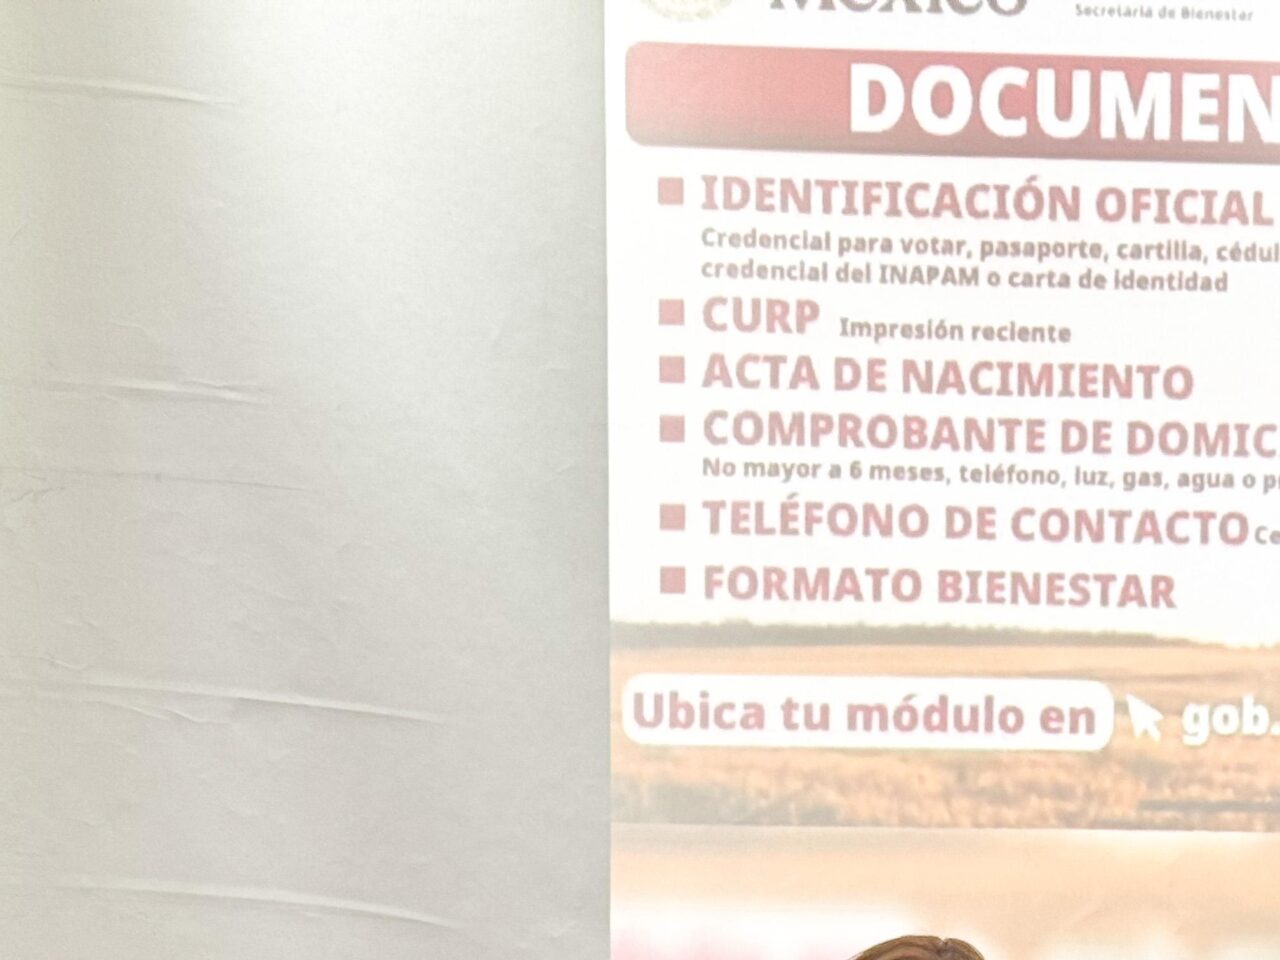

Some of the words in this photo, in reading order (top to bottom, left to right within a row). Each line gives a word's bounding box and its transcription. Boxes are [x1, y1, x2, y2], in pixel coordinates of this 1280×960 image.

[701, 175, 1080, 222] IDENTIFICACIÓN
[1095, 186, 1274, 226] OFICIAL
[701, 228, 831, 254] Credencial
[838, 236, 893, 262] para
[899, 237, 973, 259] votar,
[979, 239, 1109, 264] pasaporte,
[1117, 241, 1209, 264] cartilla,
[701, 261, 829, 283] credencial
[835, 263, 872, 284] del
[879, 265, 979, 287] INAPAM
[987, 273, 1001, 287] o
[1008, 271, 1071, 290] carta
[1078, 270, 1107, 290] de
[1114, 270, 1228, 293] identidad
[702, 296, 820, 334] CURP
[839, 317, 965, 344] Impresión
[971, 321, 1072, 344] reciente
[702, 353, 820, 391] ACTA
[834, 357, 887, 392] DE
[902, 359, 1194, 400] NACIMIENTO
[703, 410, 1046, 454] COMPROBANTE
[1060, 419, 1112, 455] DE
[702, 457, 735, 478] No
[743, 461, 821, 485] mayor
[828, 465, 843, 480] a
[849, 461, 863, 480] 6
[870, 465, 951, 485] meses,
[959, 463, 1067, 487] teléfono,
[1075, 466, 1115, 489] luz,
[1123, 473, 1170, 492] gas,
[1178, 473, 1235, 492] agua
[1242, 475, 1256, 490] o
[703, 492, 930, 540] TELÉFONO
[945, 505, 997, 541] DE
[1011, 507, 1249, 545] CONTACTO
[704, 566, 922, 603] FORMATO
[938, 570, 1177, 609] BIENESTAR
[633, 691, 766, 730] Ubica
[780, 697, 830, 731] tu
[847, 694, 1025, 734] módulo
[1039, 705, 1096, 735] en
